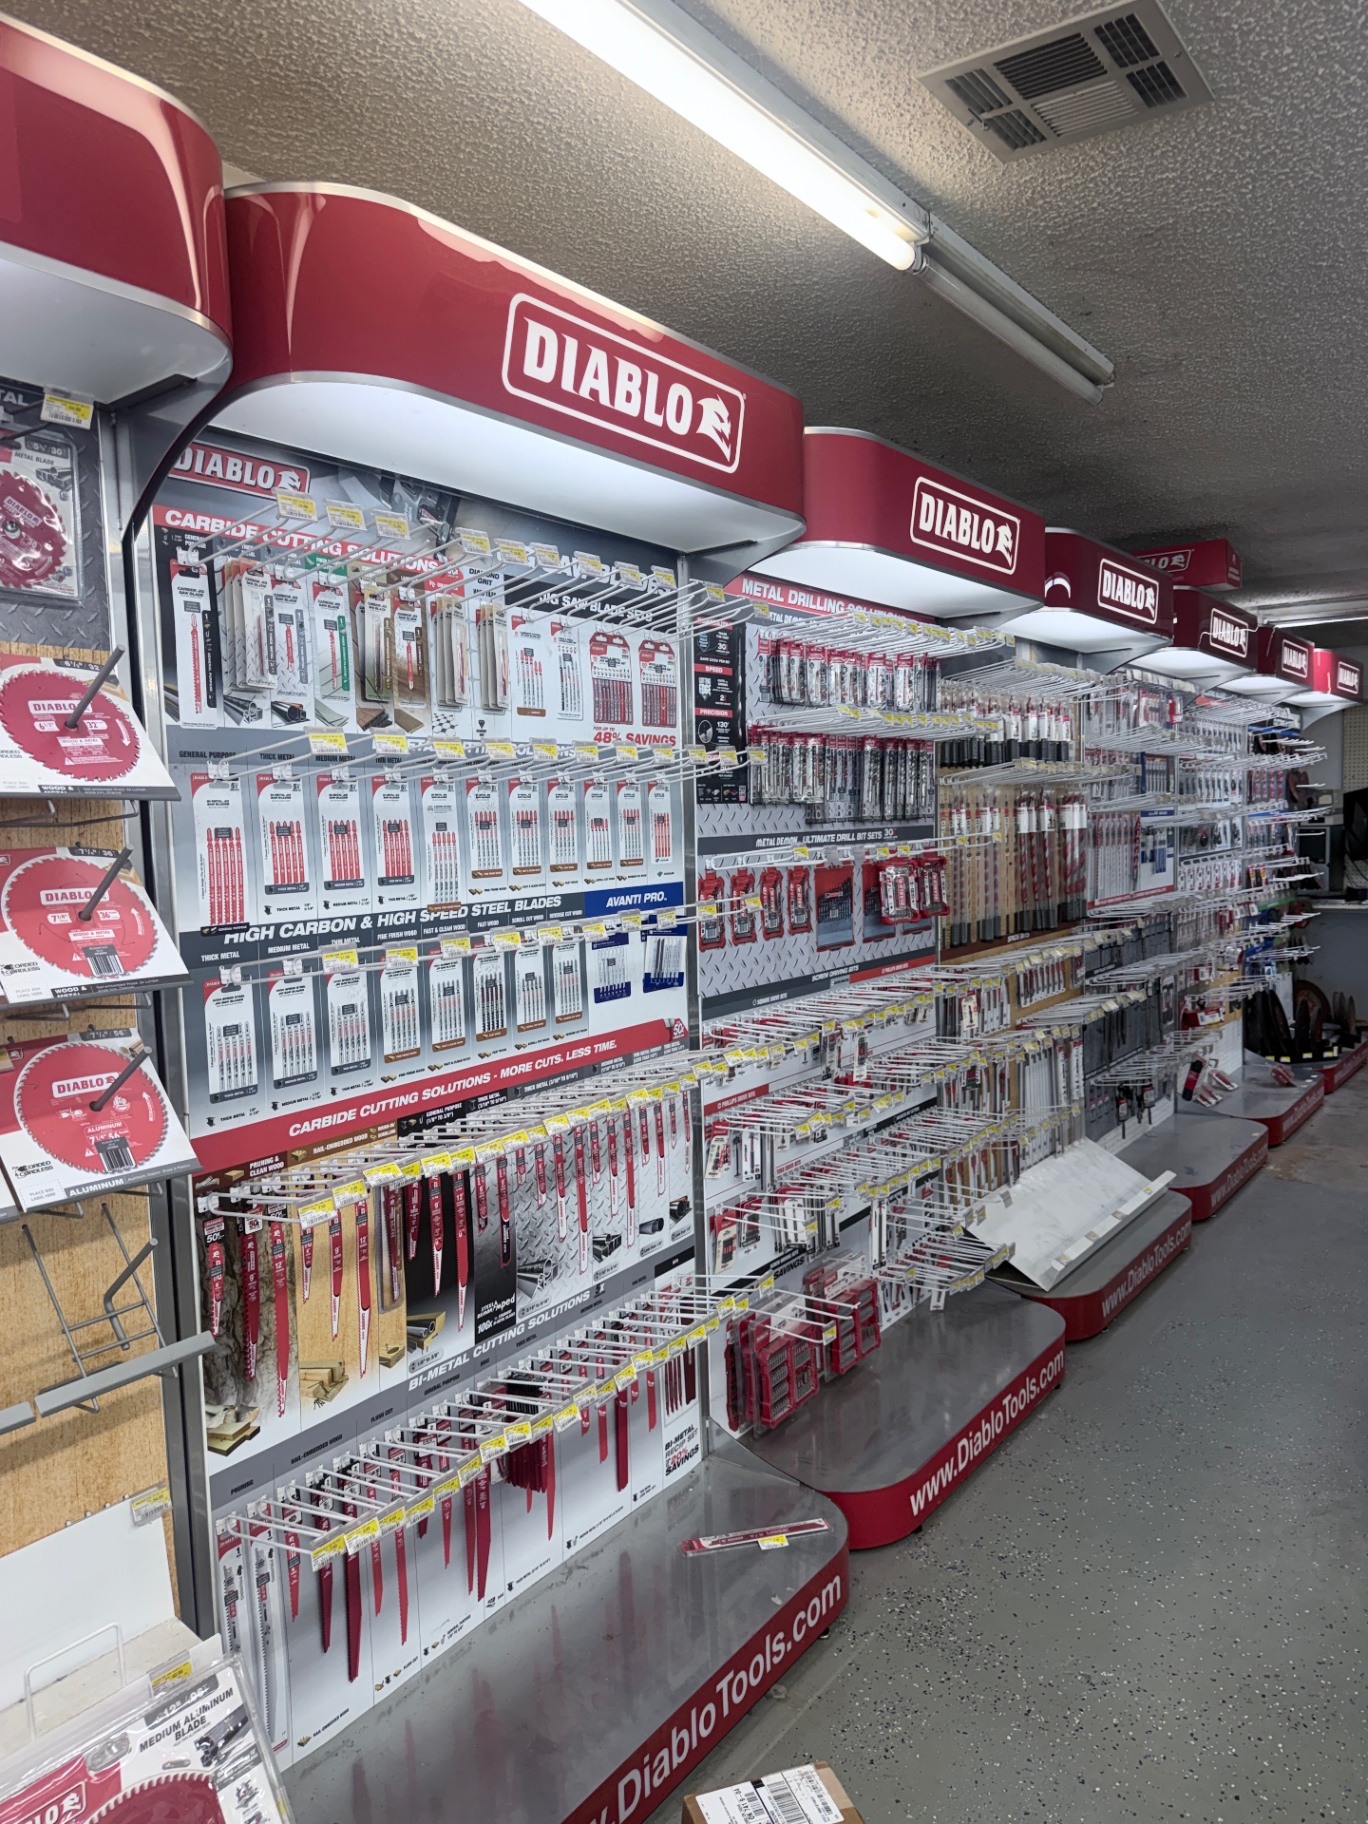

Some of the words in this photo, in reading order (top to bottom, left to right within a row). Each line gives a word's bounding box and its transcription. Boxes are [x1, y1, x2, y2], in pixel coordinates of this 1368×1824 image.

[523, 316, 693, 436] DIABLO
[15, 452, 34, 461] METAL
[35, 457, 55, 465] BLADE
[174, 446, 276, 490] DIABLO
[165, 509, 259, 539] CARBIDE
[918, 491, 995, 554] DIABLO
[477, 577, 493, 586] GRIT
[1102, 569, 1145, 611] DIABLO
[561, 596, 588, 611] SAW
[741, 578, 784, 602] METAL
[787, 589, 844, 614] DRILLING
[1212, 616, 1240, 648] DIABLO
[1282, 648, 1302, 670] DIABLO
[705, 665, 723, 674] SPEED
[1338, 667, 1356, 688] DIABLO
[699, 709, 729, 717] PRECISION
[593, 732, 622, 744] 48%
[625, 733, 677, 746] SAVINGS
[178, 751, 207, 759] GENERAL
[315, 755, 338, 763] MEDIUM
[802, 833, 835, 845] ULTIMATE
[836, 832, 855, 843] DRILL
[856, 832, 867, 841] BIT
[867, 831, 883, 840] SETS
[606, 893, 642, 908] AVANTI
[279, 917, 357, 939] CARBON
[360, 914, 374, 929] &
[377, 911, 417, 928] HIGH
[471, 900, 512, 918] STEEL
[514, 896, 562, 913] BLADES
[377, 933, 388, 941] FINE
[388, 931, 404, 939] FINISH
[404, 929, 418, 938] WOOD
[423, 927, 436, 935] FAST
[440, 925, 454, 933] CLEAN
[454, 924, 466, 932] WOOD
[200, 954, 220, 962] THICK
[220, 951, 240, 960] METAL
[267, 945, 291, 954] MEDIUM
[291, 942, 310, 951] METAL
[811, 973, 829, 982] SCREW
[829, 968, 847, 979] DRIVING
[848, 965, 860, 974] BITS
[54, 986, 80, 994] WOOD
[56, 1077, 105, 1094] DIABLO
[289, 1110, 358, 1138] CARBIDE
[359, 1094, 419, 1119] CUTTING
[421, 1072, 491, 1101] SOLUTIONS
[500, 1061, 532, 1079] MORE
[534, 1053, 564, 1069] CUTS.
[565, 1046, 592, 1061] LESS
[593, 1039, 618, 1054] TIME.
[425, 1108, 443, 1118] GENERAL
[443, 1103, 463, 1114] PURPOSE
[721, 1097, 738, 1109] PHILLIPS
[87, 1121, 123, 1134] ALUMINUM
[312, 1136, 353, 1155] NAIL-EMBEDDED
[354, 1133, 368, 1143] WOOD
[249, 1160, 273, 1170] PRUNING
[249, 1166, 267, 1177] CLEAN
[267, 1162, 285, 1173] WOOD
[69, 1178, 125, 1197] ALUMINUM
[774, 1257, 805, 1280] SAVINGS
[1101, 1220, 1192, 1318] www.DiabloTools.com
[408, 1355, 470, 1392] BI-METAL
[472, 1322, 526, 1359] CUTTING
[527, 1290, 591, 1330] SOLUTIONS
[423, 1383, 441, 1397] GENERAL
[441, 1373, 461, 1387] PURPOSE
[370, 1411, 385, 1423] FLUSH
[665, 1424, 695, 1451] BI-METAL
[909, 1350, 1065, 1517] www.DiabloTools.com
[290, 1442, 329, 1465] NAIL-EMBEDDED
[329, 1434, 343, 1446] WOOD
[665, 1439, 686, 1459] RECIP
[687, 1428, 698, 1443] SET
[665, 1443, 699, 1477] SAVINGS
[670, 1446, 688, 1466] 20%
[230, 1480, 254, 1496] PRUNING
[589, 1574, 842, 1824] .DiabloTools.com
[139, 1721, 181, 1753] MEDIUM
[183, 1687, 234, 1724] ALUMINUM
[175, 1714, 207, 1742] BLADE
